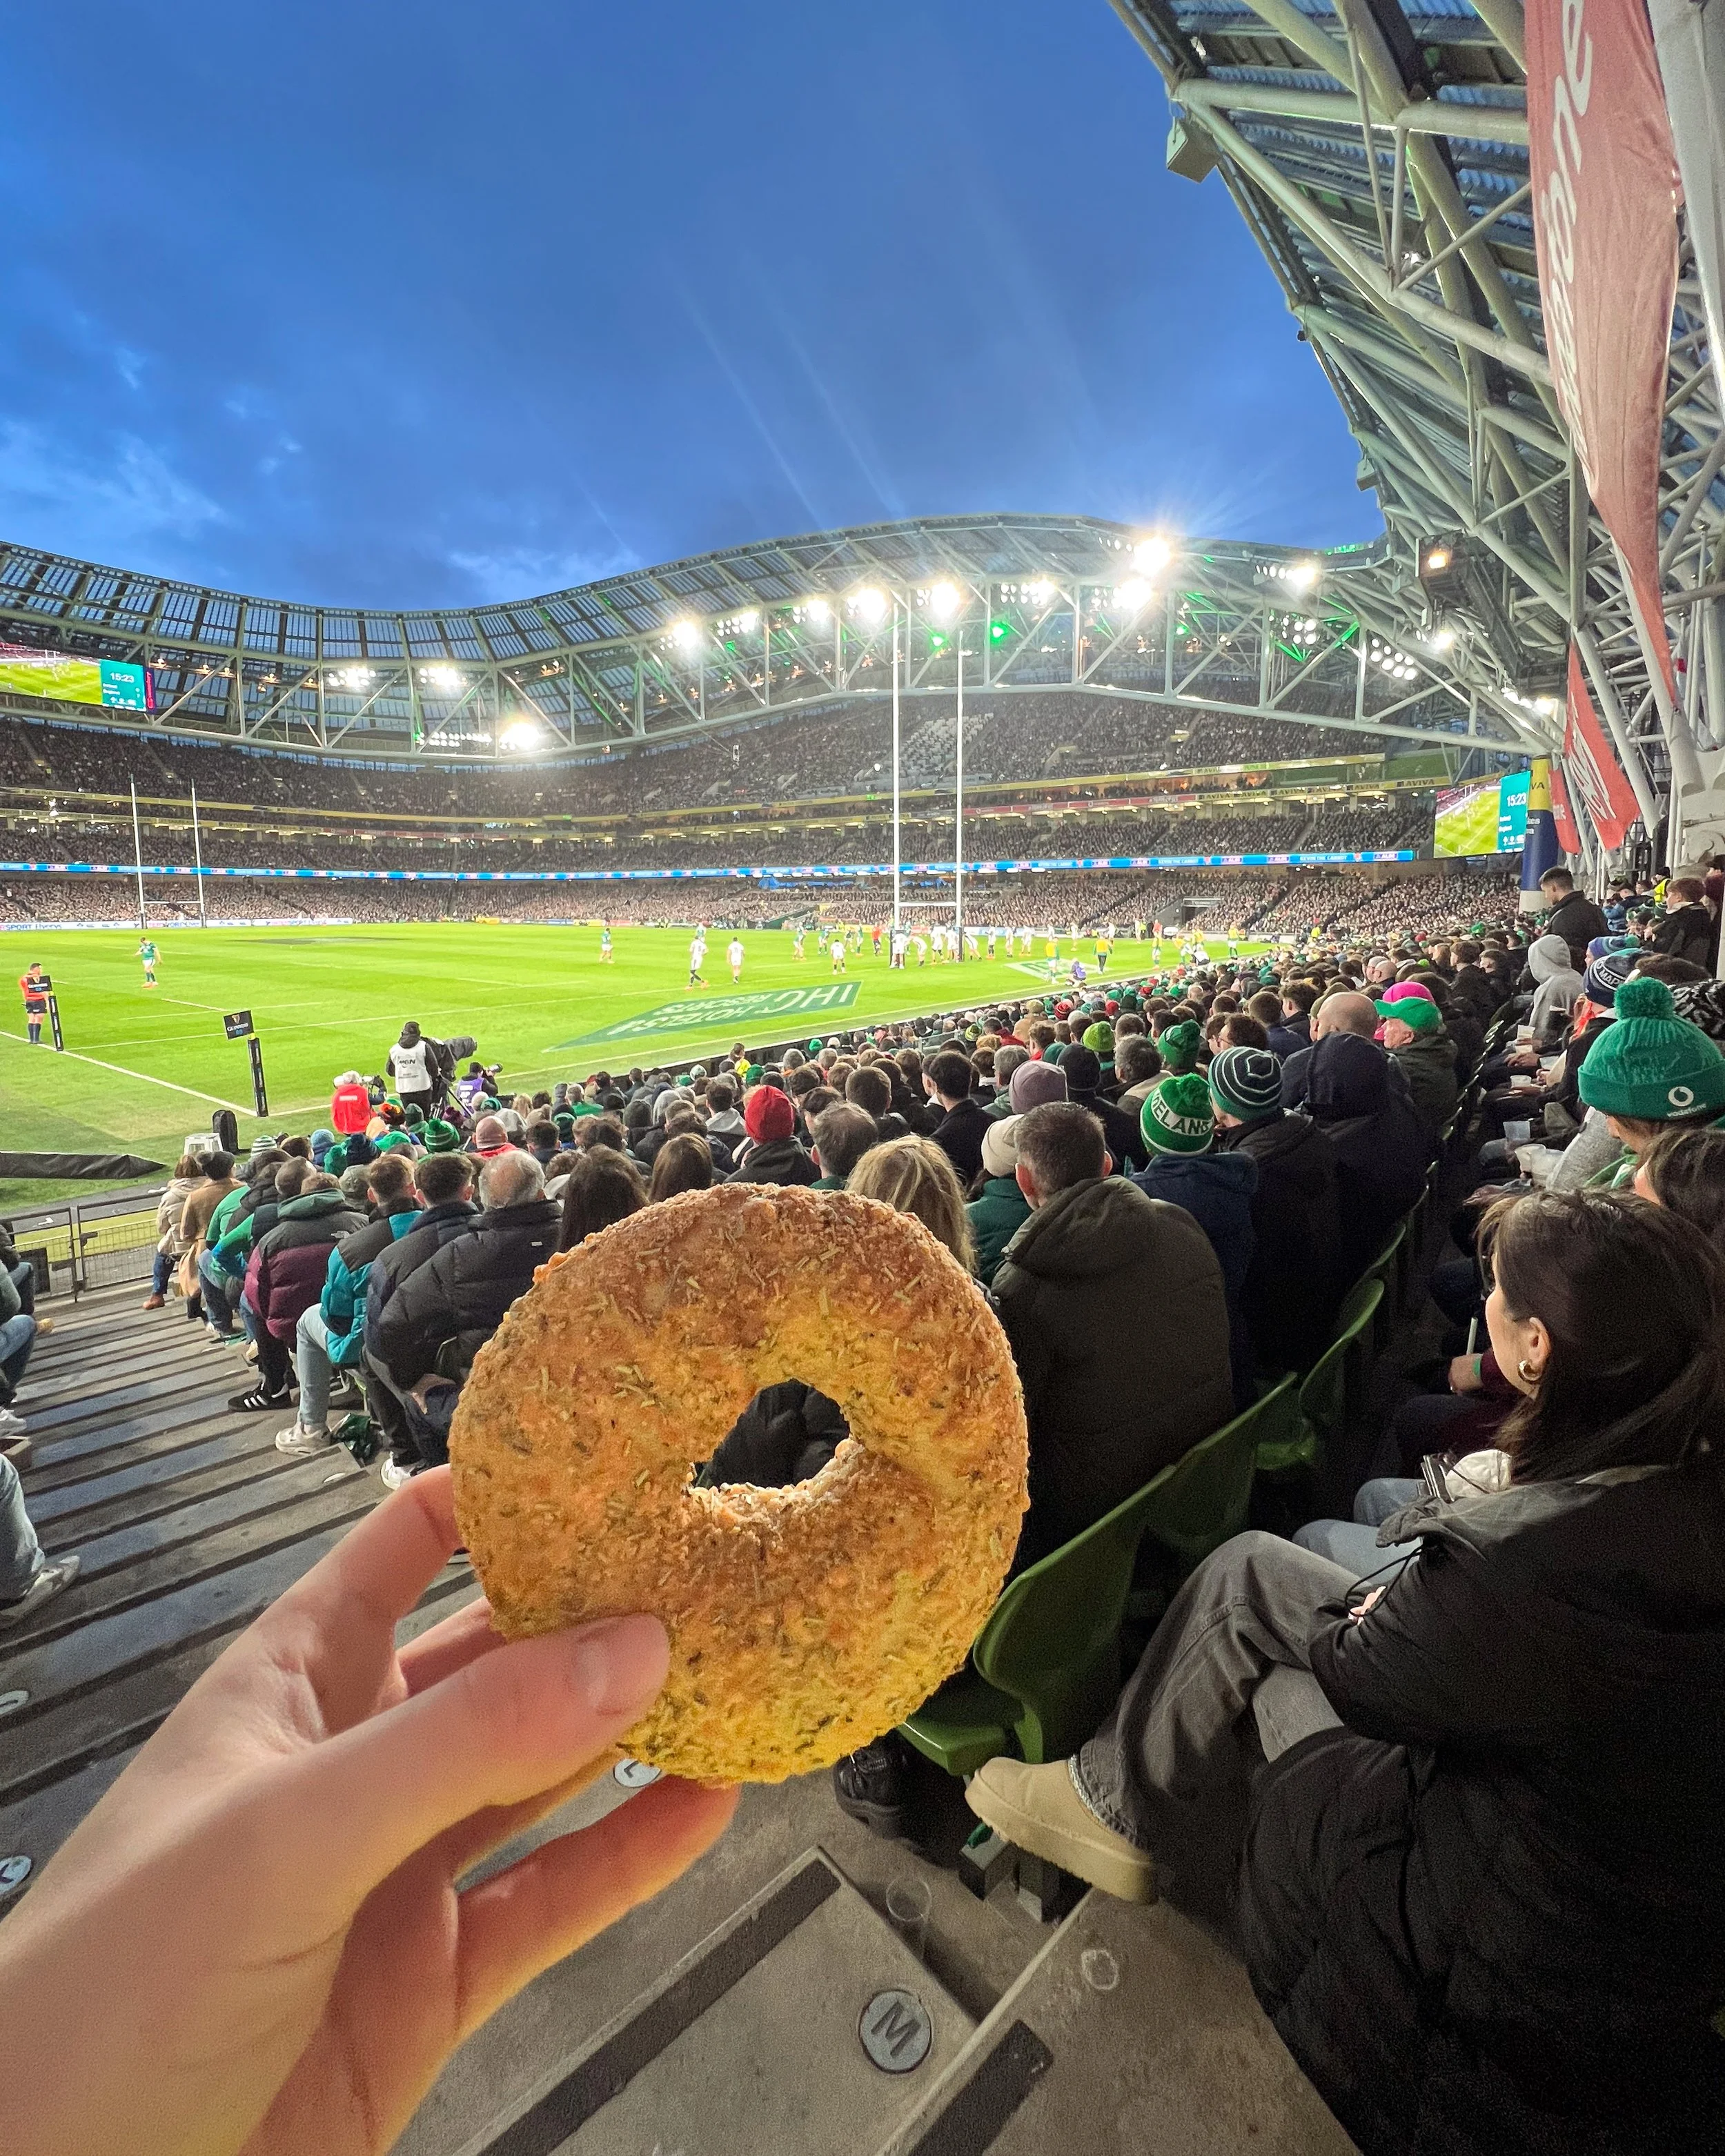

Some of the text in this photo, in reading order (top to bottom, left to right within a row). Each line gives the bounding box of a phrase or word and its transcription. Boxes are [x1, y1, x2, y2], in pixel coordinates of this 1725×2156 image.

[110, 672, 135, 683] 15:23
[1506, 792, 1527, 807] 15:23
[653, 993, 773, 1016] RESORTS
[755, 984, 854, 1014] IHG
[1666, 1104, 1706, 1117] vodafone
[871, 2001, 921, 2057] M
